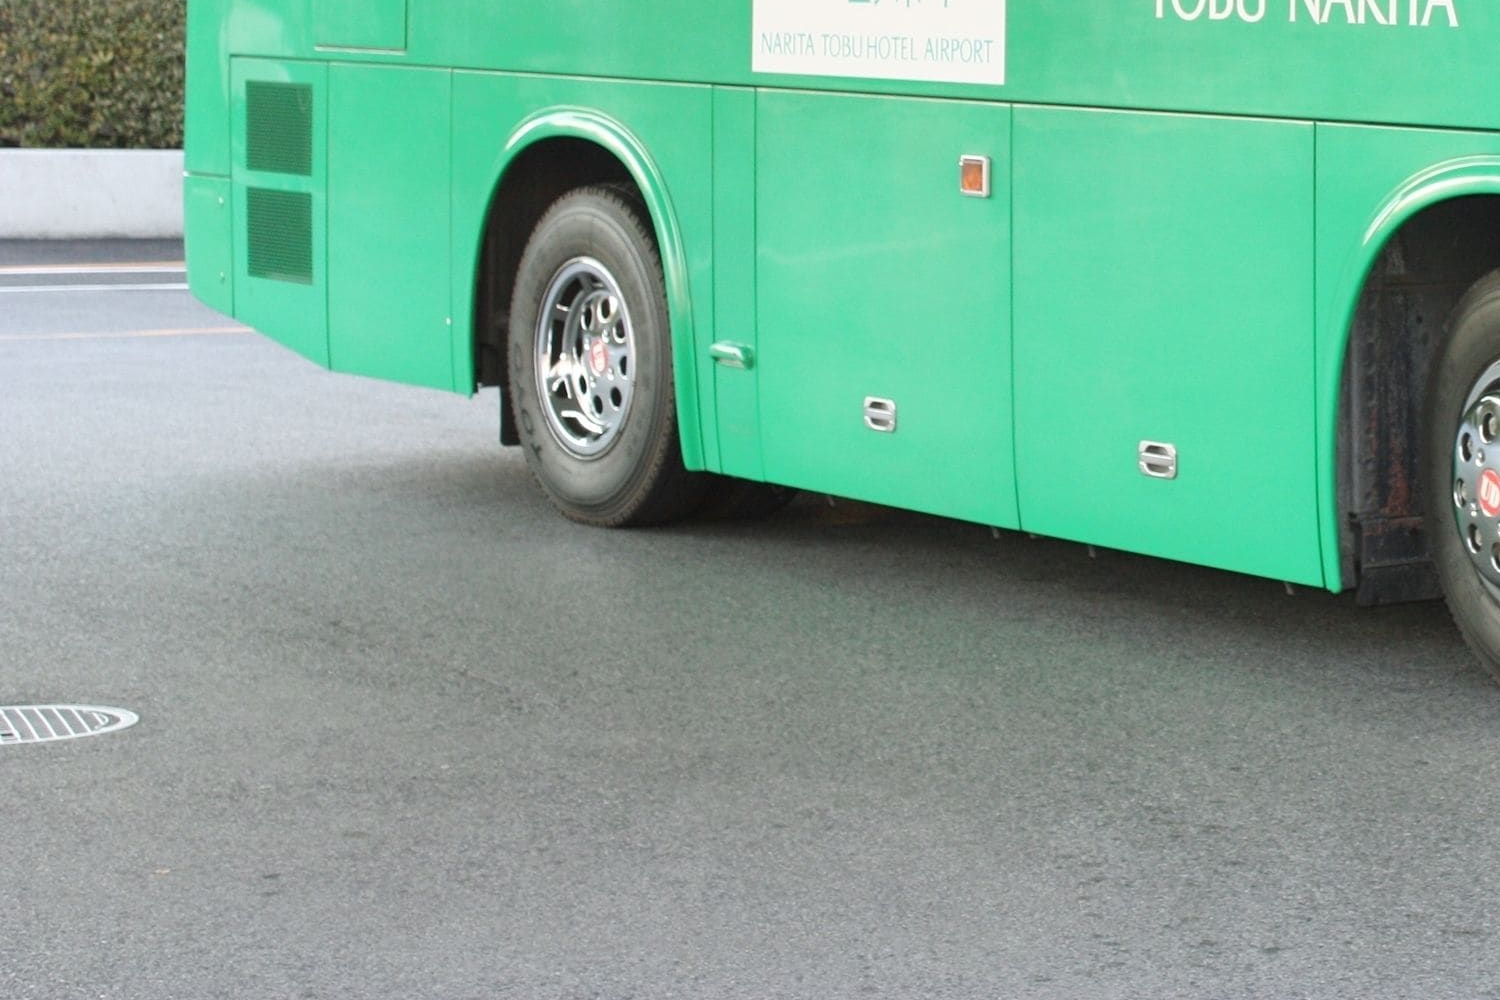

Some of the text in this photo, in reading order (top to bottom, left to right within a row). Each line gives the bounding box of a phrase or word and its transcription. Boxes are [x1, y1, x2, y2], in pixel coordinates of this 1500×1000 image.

[761, 32, 994, 64] NARITA TOBU HOTEL AIRPORT
